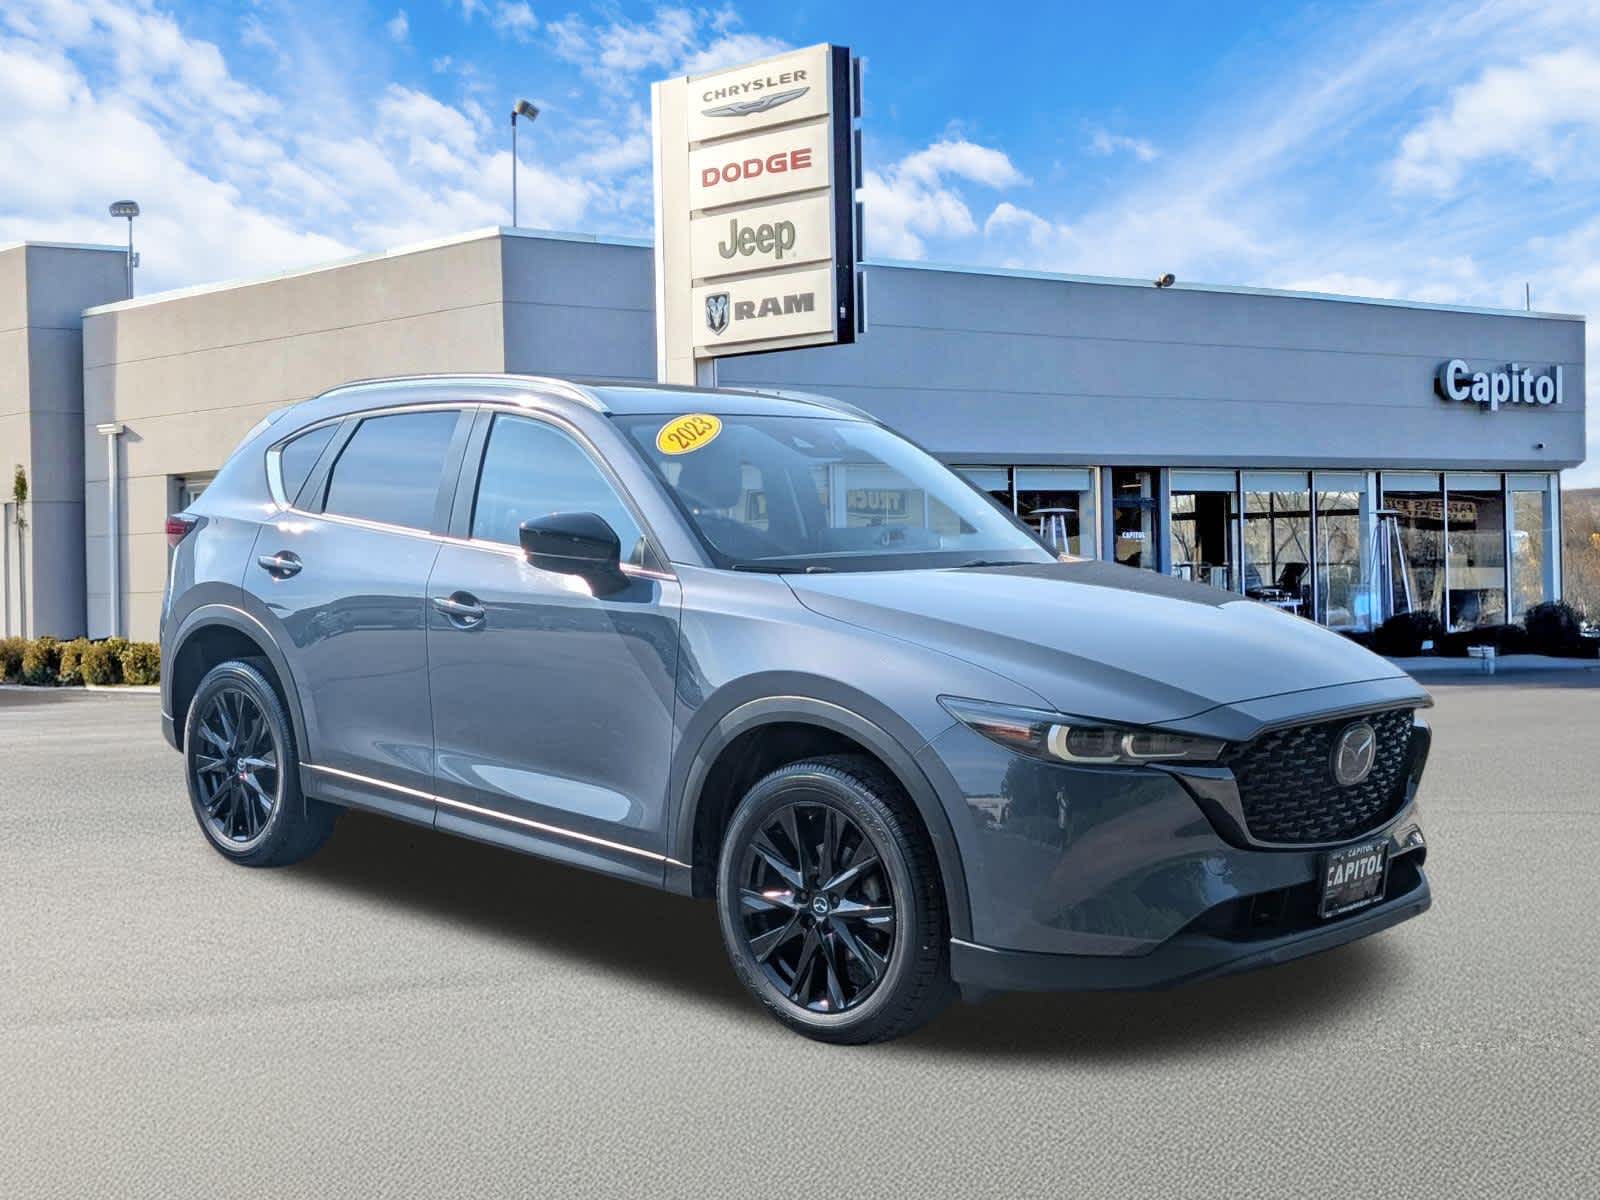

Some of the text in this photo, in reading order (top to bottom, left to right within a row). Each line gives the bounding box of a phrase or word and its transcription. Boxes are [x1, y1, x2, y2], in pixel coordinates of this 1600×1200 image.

[702, 70, 808, 102] CHRYSLER
[702, 148, 812, 187] DODGE
[718, 218, 795, 259] Jeep
[734, 292, 815, 320] RAM
[1446, 359, 1562, 411] Capitol
[668, 417, 712, 448] 2023
[1327, 854, 1383, 887] CAPITOL
